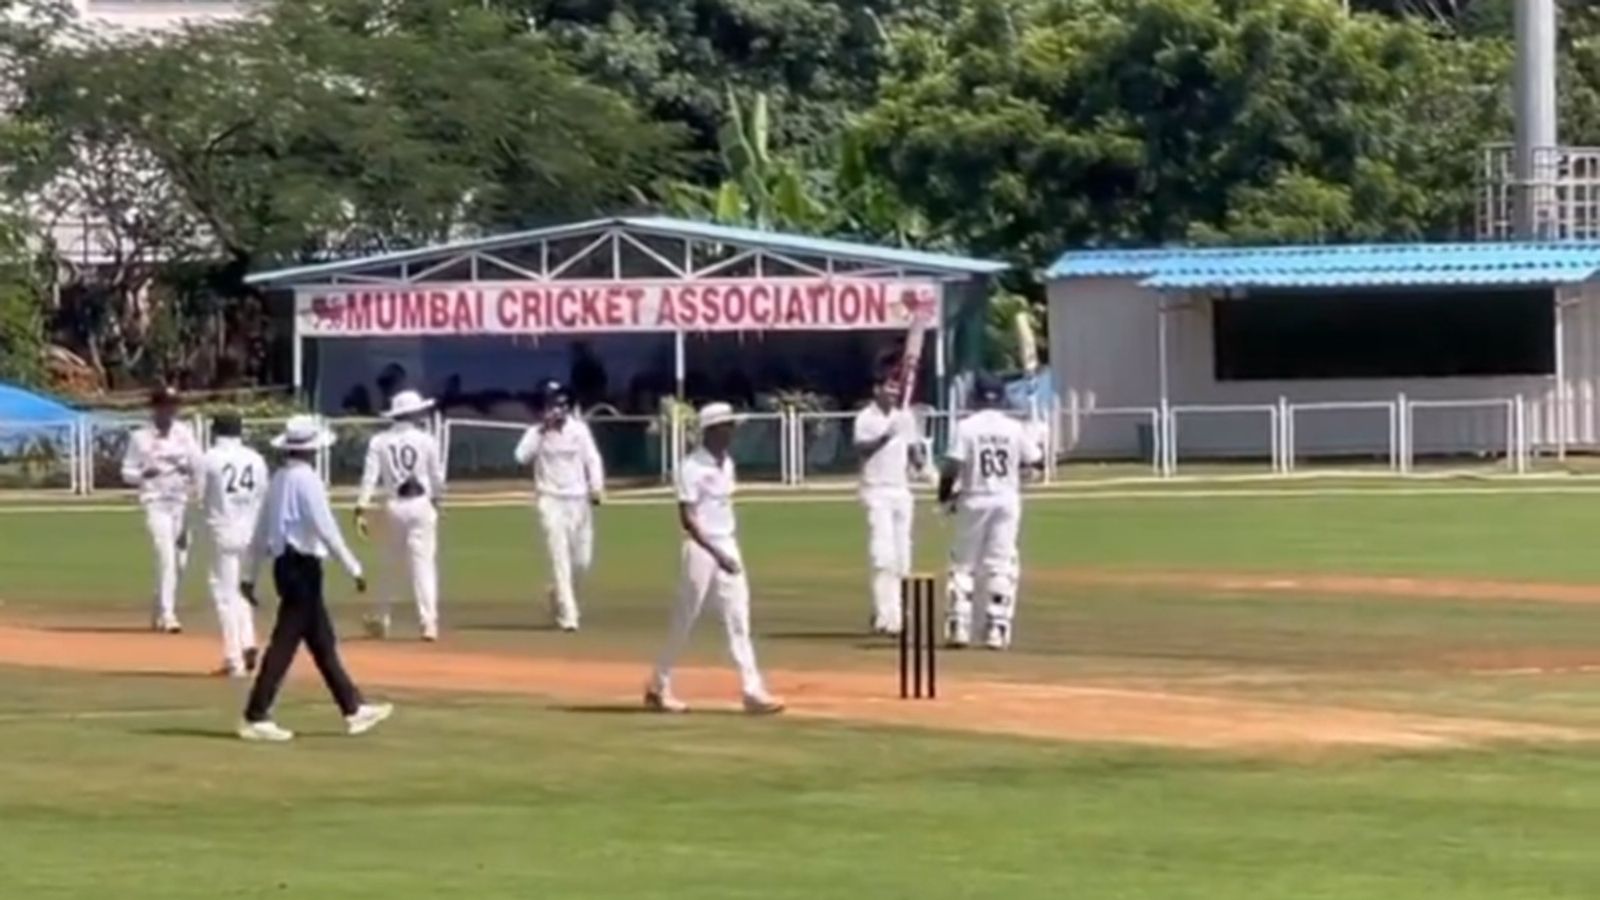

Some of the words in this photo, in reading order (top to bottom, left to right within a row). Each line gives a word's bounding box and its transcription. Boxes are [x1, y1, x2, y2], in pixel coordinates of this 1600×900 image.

[347, 290, 484, 330] MUMBAI
[497, 286, 645, 328] CRICKET
[657, 283, 886, 325] ASSOCIATION
[390, 444, 418, 471] 10
[980, 449, 1008, 478] 63
[222, 463, 254, 493] 24
